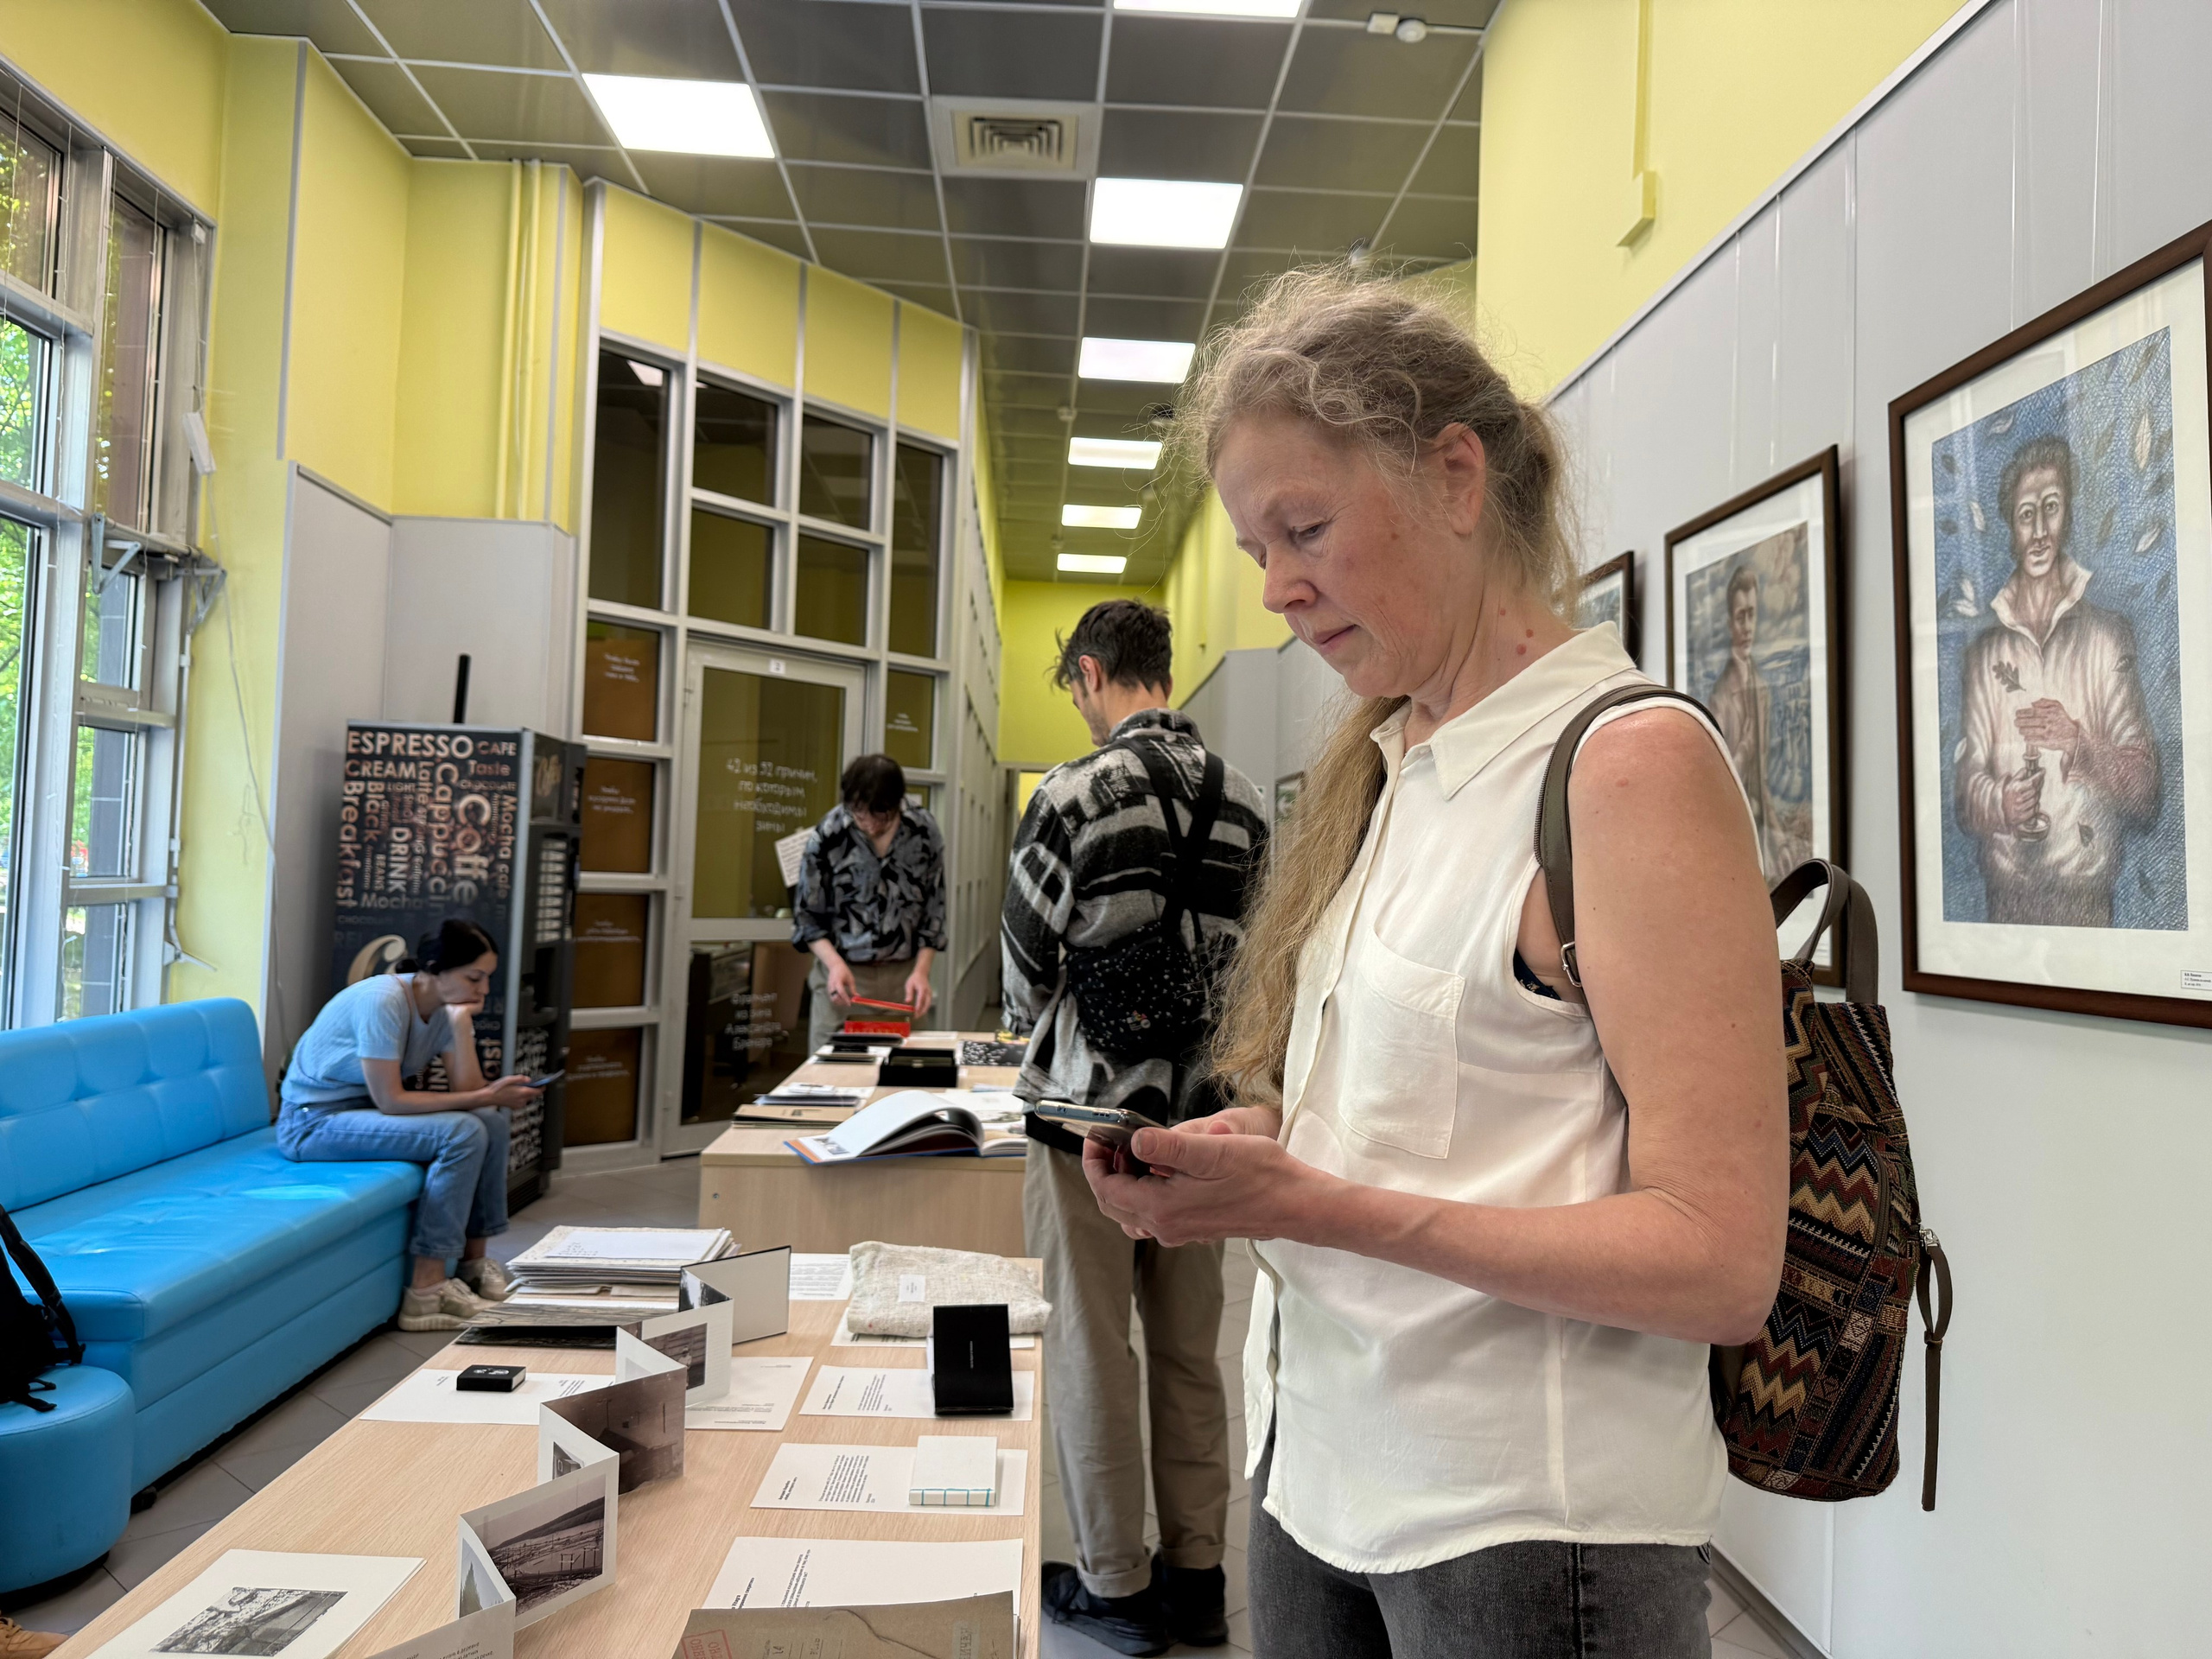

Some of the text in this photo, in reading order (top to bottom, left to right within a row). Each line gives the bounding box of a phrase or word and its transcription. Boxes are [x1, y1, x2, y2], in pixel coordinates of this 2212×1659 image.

[346, 759, 416, 779] CREAM
[347, 730, 517, 759] ESPRESSO CAFE
[363, 780, 385, 842] Black
[418, 760, 434, 805] Latte
[336, 780, 365, 908] Breakfast
[499, 794, 518, 860] Mocha
[387, 827, 412, 893] DRINK
